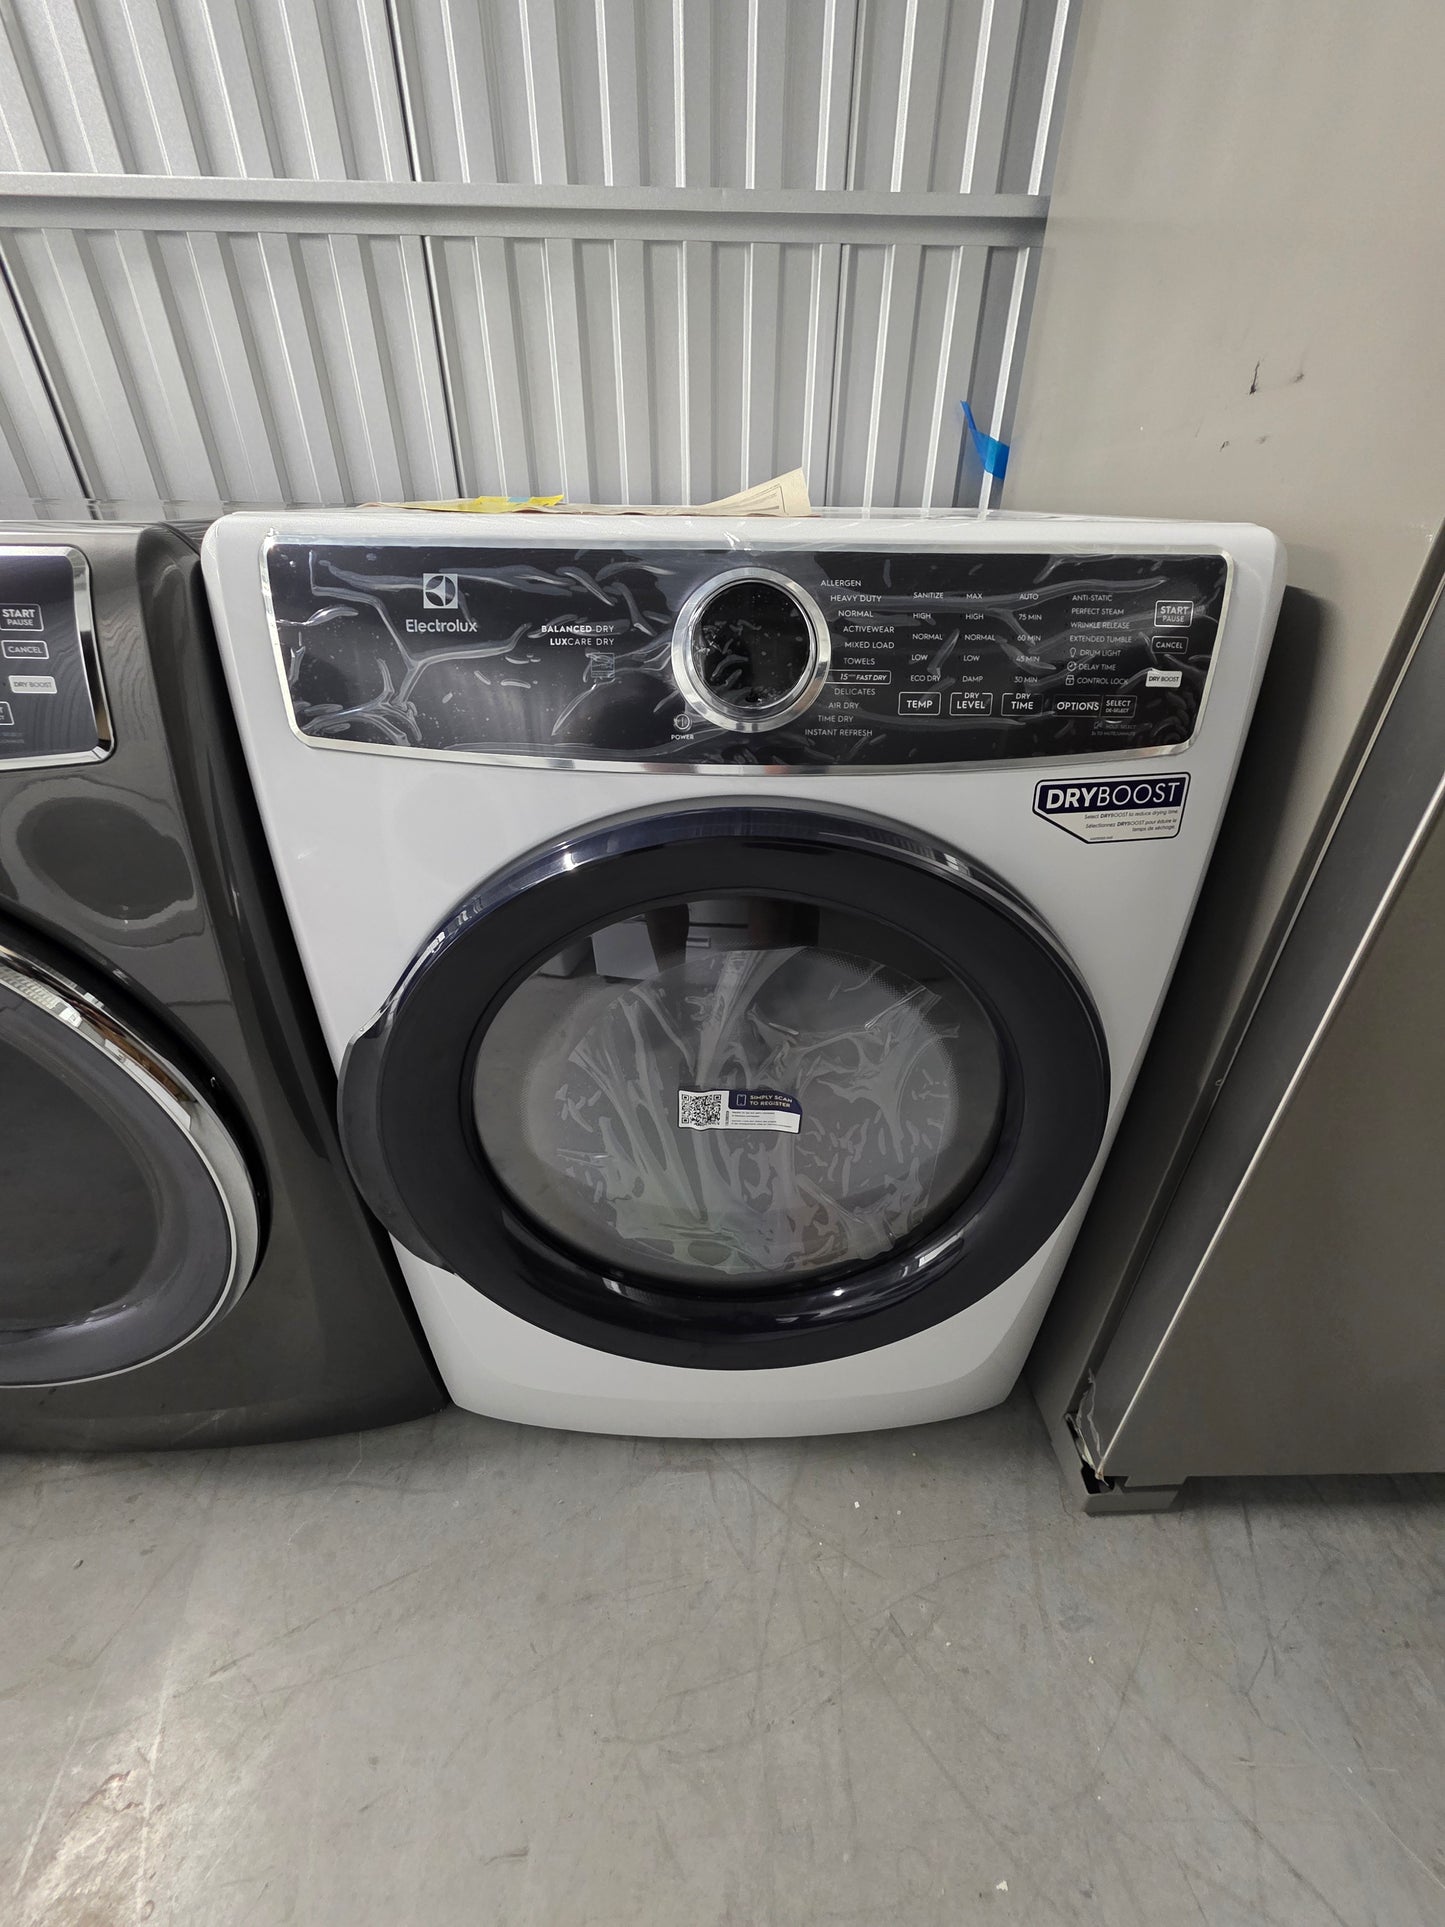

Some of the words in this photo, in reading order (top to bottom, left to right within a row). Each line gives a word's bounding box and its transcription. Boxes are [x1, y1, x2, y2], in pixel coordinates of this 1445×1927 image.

[2, 608, 35, 618] START
[1160, 606, 1189, 615] START
[406, 619, 478, 633] Electrolux
[541, 625, 592, 633] BALANCED
[596, 625, 614, 633] DRY
[550, 637, 592, 646] LUXCARE
[596, 637, 614, 646] DRY
[906, 700, 933, 708] TEMP
[1011, 702, 1034, 710] TIME
[1057, 702, 1099, 711] OPTIONS
[1046, 782, 1180, 809] DRYBOOST
